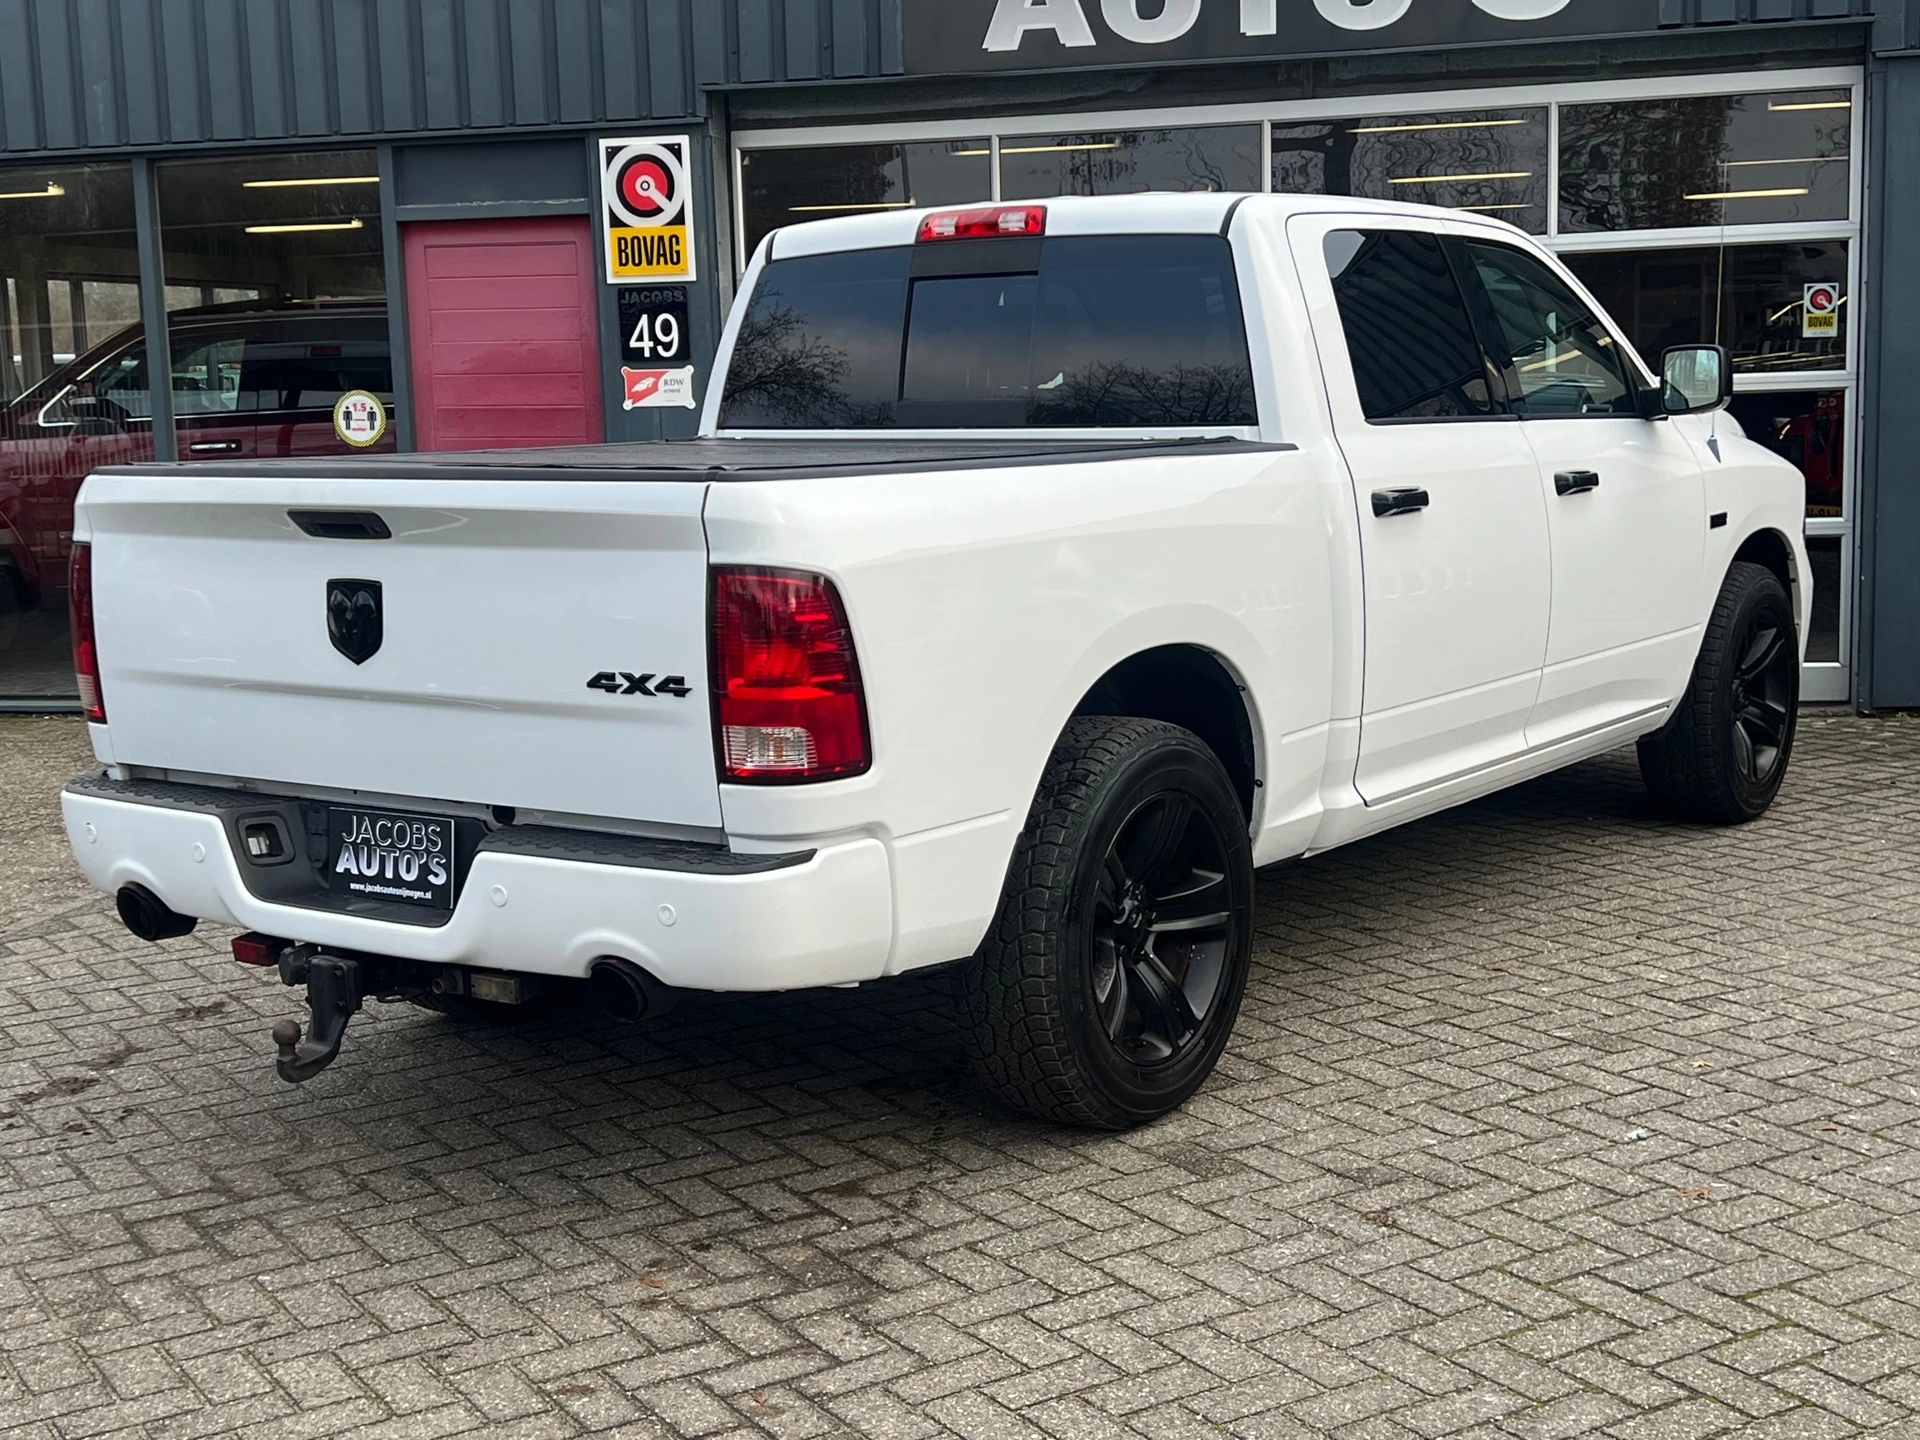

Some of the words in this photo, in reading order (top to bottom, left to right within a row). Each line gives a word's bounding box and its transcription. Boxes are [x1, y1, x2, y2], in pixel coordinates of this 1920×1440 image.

[617, 235, 681, 267] BOVAG
[621, 290, 684, 304] JACOBS
[629, 313, 680, 358] 49
[1808, 316, 1834, 328] BOVAG
[663, 378, 684, 387] RDW
[341, 815, 442, 852] JACOBS
[335, 843, 447, 886] AUTO'S
